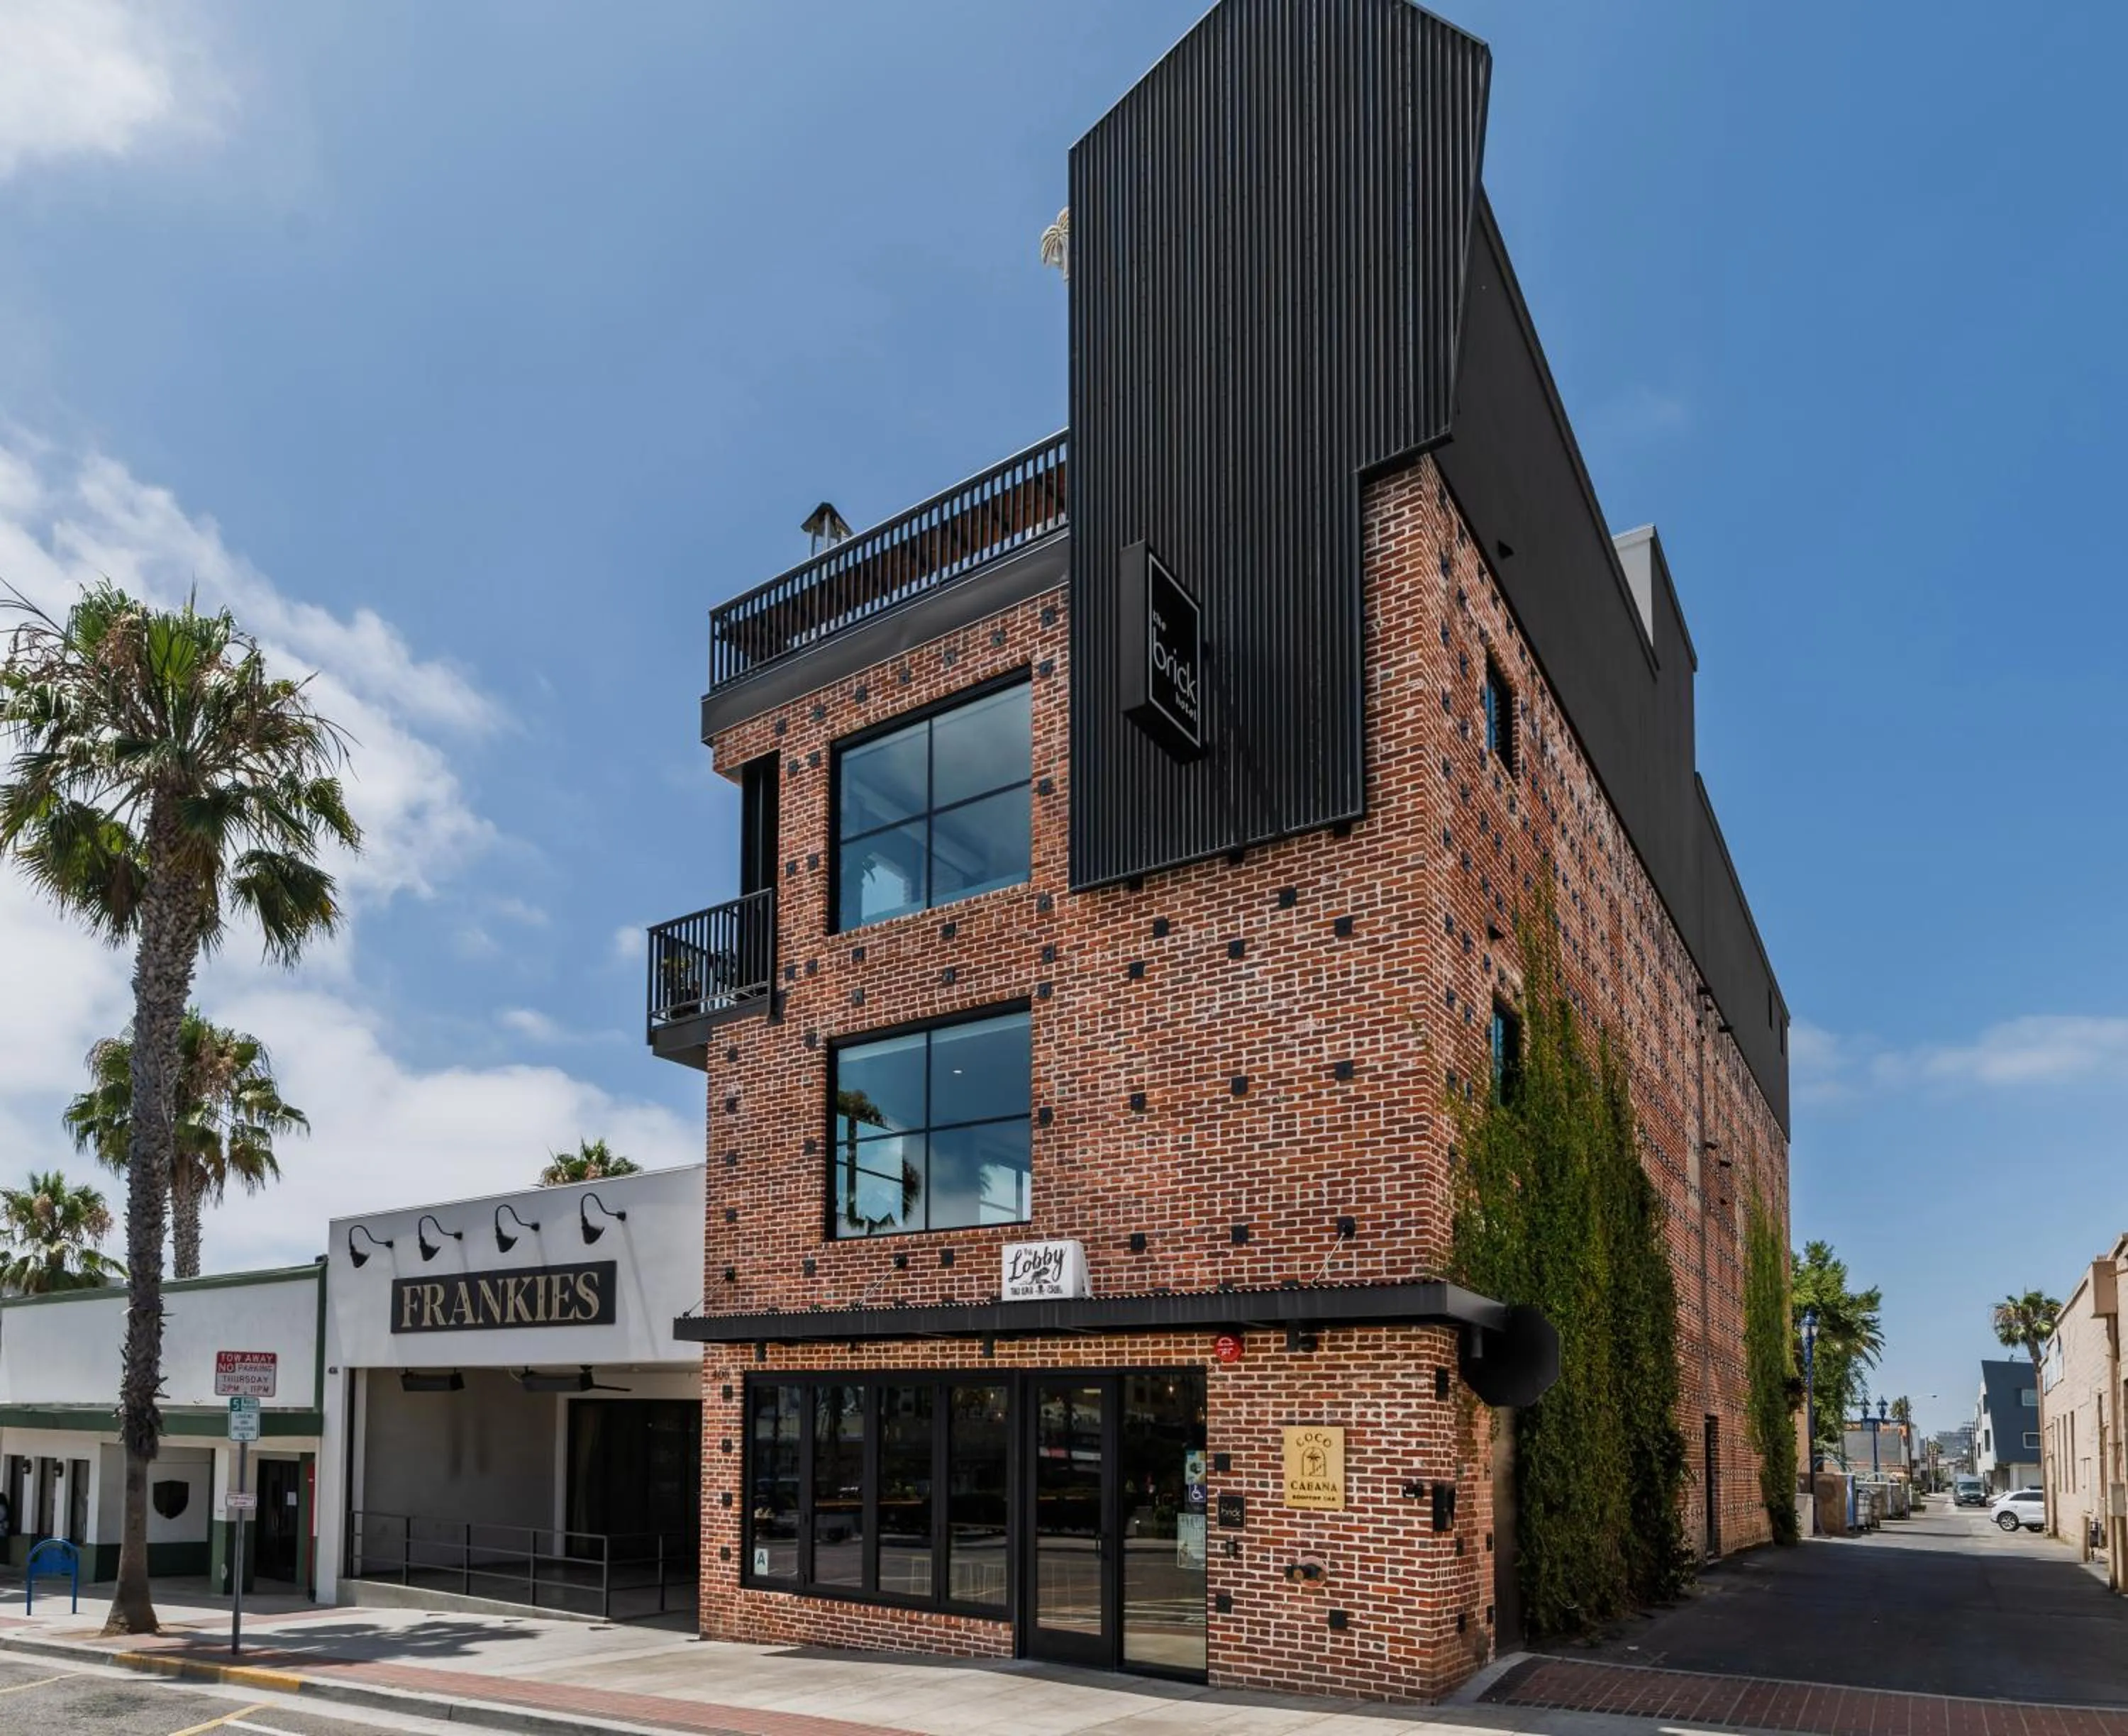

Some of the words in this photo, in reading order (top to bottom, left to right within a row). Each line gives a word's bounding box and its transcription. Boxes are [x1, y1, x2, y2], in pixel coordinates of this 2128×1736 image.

[1153, 626, 1197, 704] brick
[1007, 1246, 1067, 1282] Lobby
[401, 1272, 600, 1328] FRANKIES
[220, 1352, 241, 1362] TOW
[245, 1353, 273, 1363] AWAY
[218, 1362, 234, 1372] NO
[222, 1375, 268, 1384] THURSDAY
[233, 1398, 239, 1410] 5
[1296, 1432, 1332, 1448] COCO
[1290, 1480, 1338, 1492] CABANA
[757, 1551, 765, 1566] A
